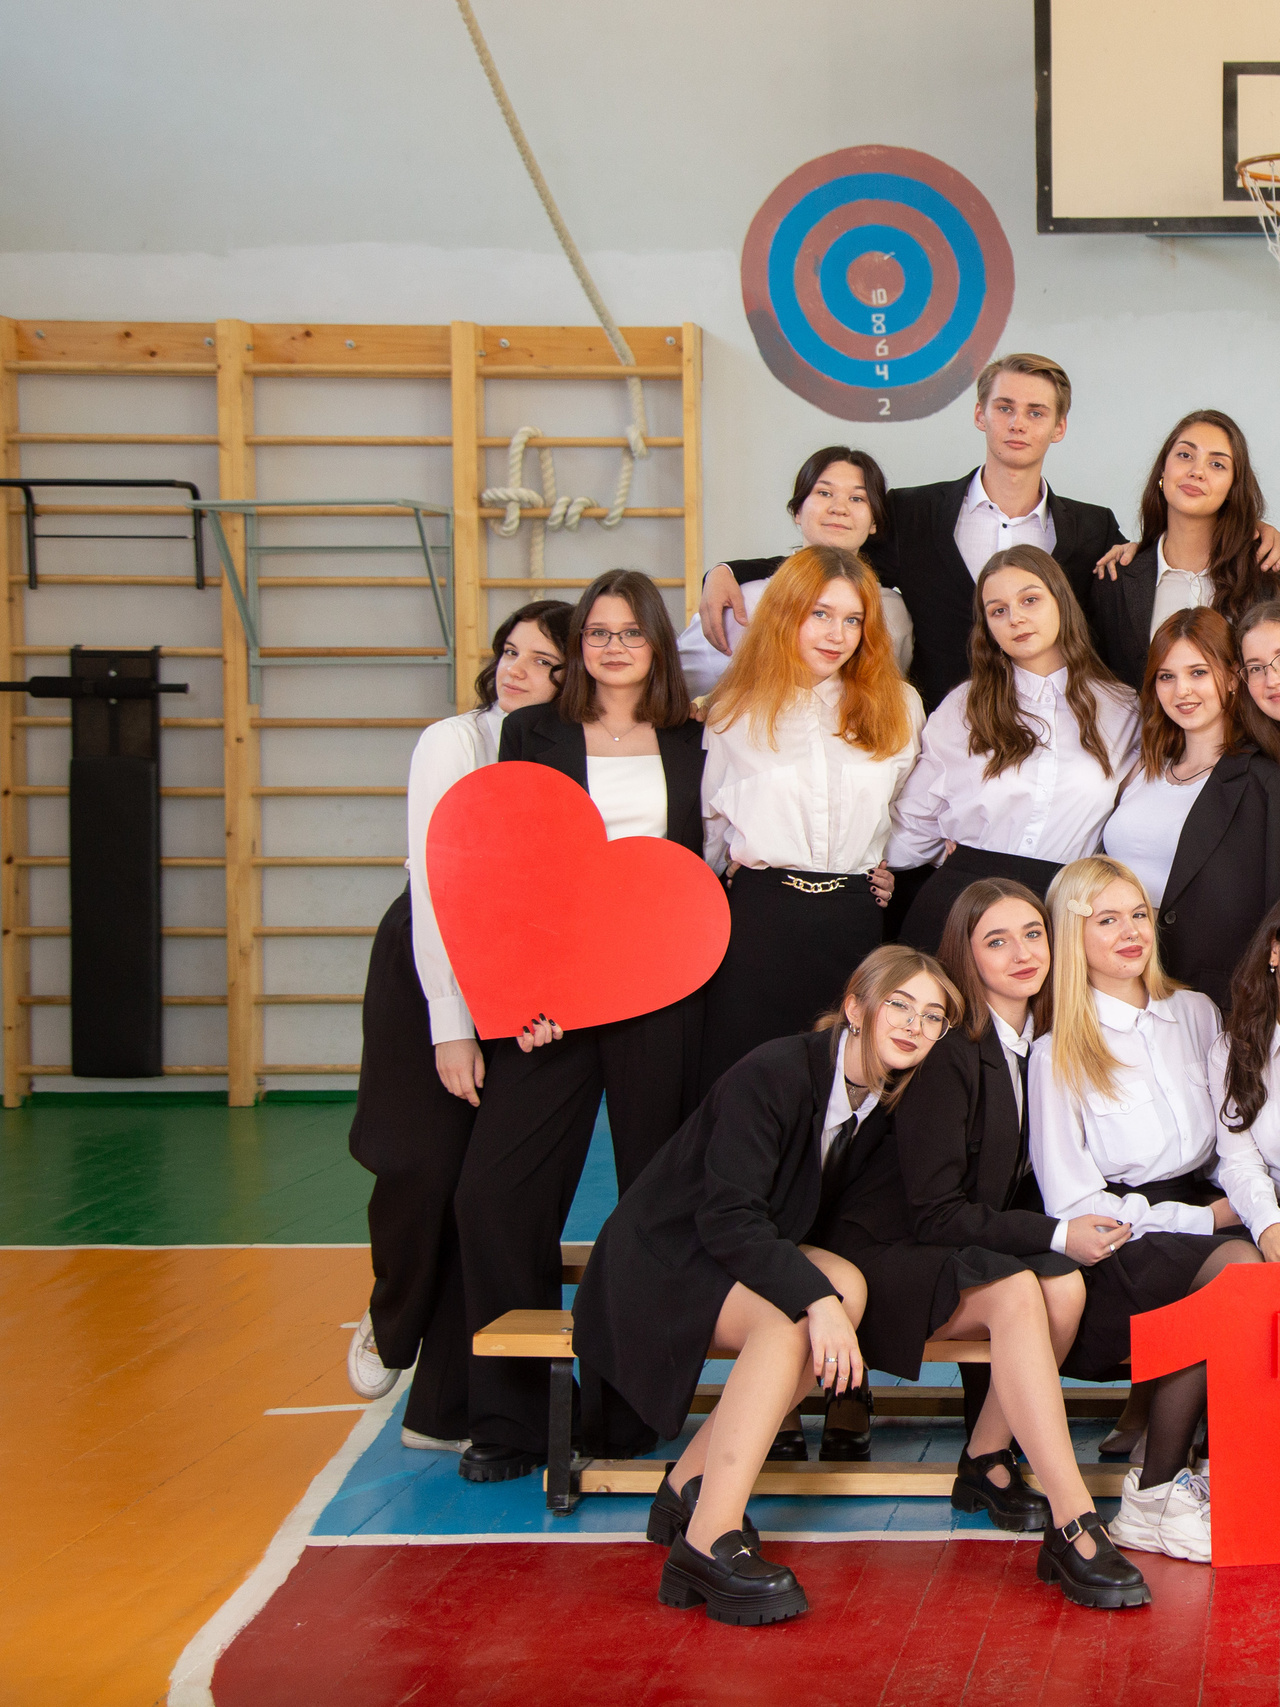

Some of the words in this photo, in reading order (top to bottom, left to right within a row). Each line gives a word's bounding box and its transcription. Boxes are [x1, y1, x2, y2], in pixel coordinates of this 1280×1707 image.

[872, 288, 888, 305] 10
[871, 313, 886, 334] 8
[875, 338, 889, 357] 6
[875, 364, 889, 381] 4
[878, 398, 891, 416] 2
